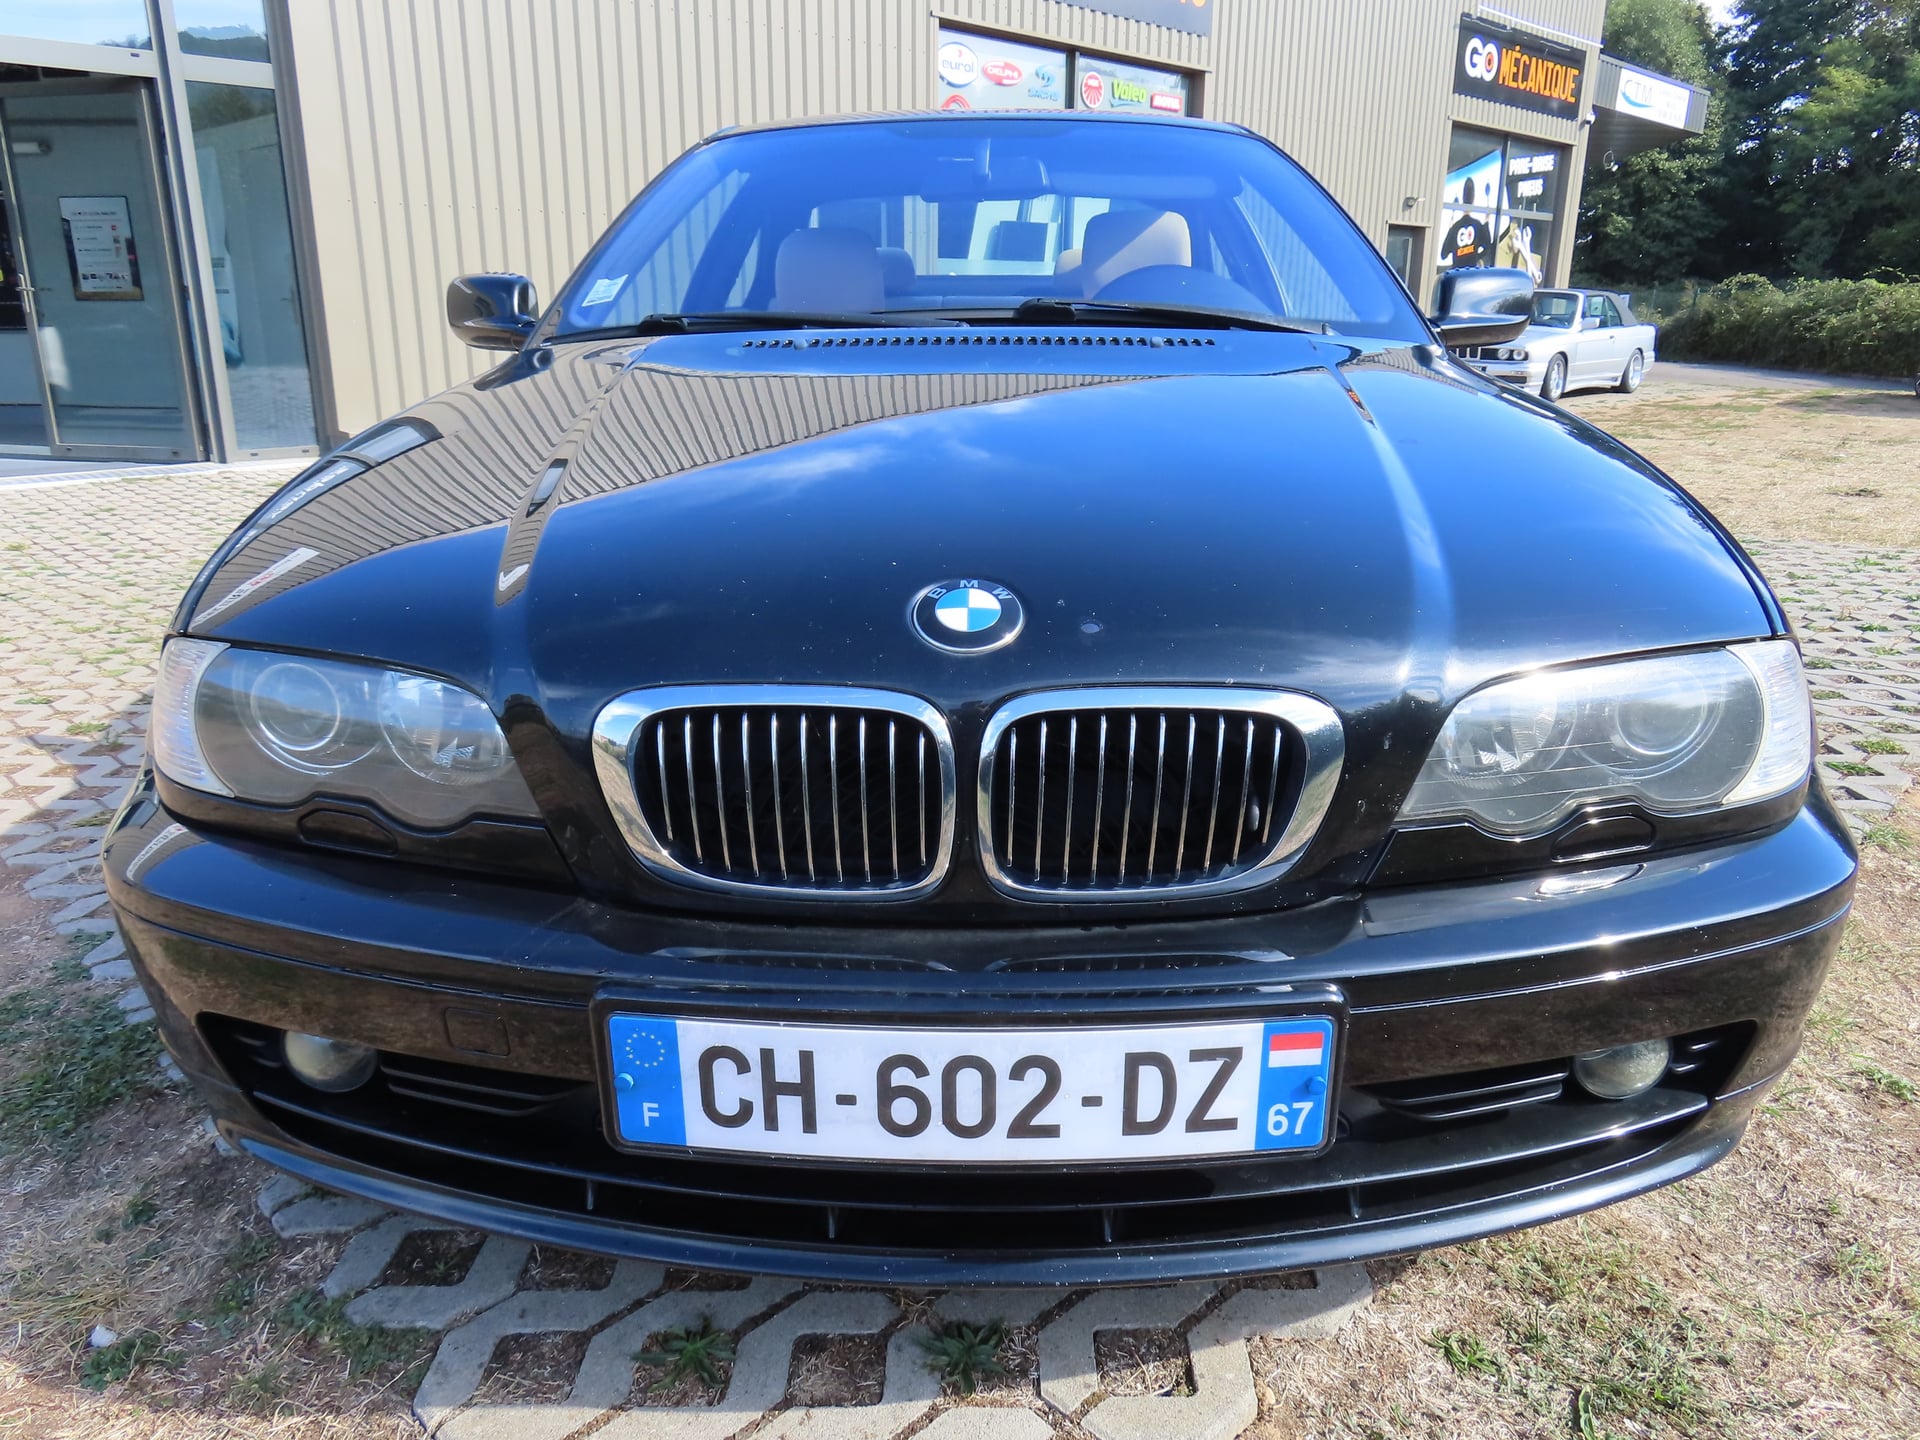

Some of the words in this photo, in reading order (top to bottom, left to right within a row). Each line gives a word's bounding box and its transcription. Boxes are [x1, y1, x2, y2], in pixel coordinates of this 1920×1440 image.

[941, 59, 975, 73] eurol
[1465, 37, 1499, 82] GO
[1498, 44, 1580, 104] MÉCANIQUE
[1111, 79, 1148, 103] Valeo
[1457, 225, 1475, 247] GO
[927, 579, 1013, 600] BMW
[643, 1102, 660, 1127] F
[1267, 1101, 1314, 1137] 67
